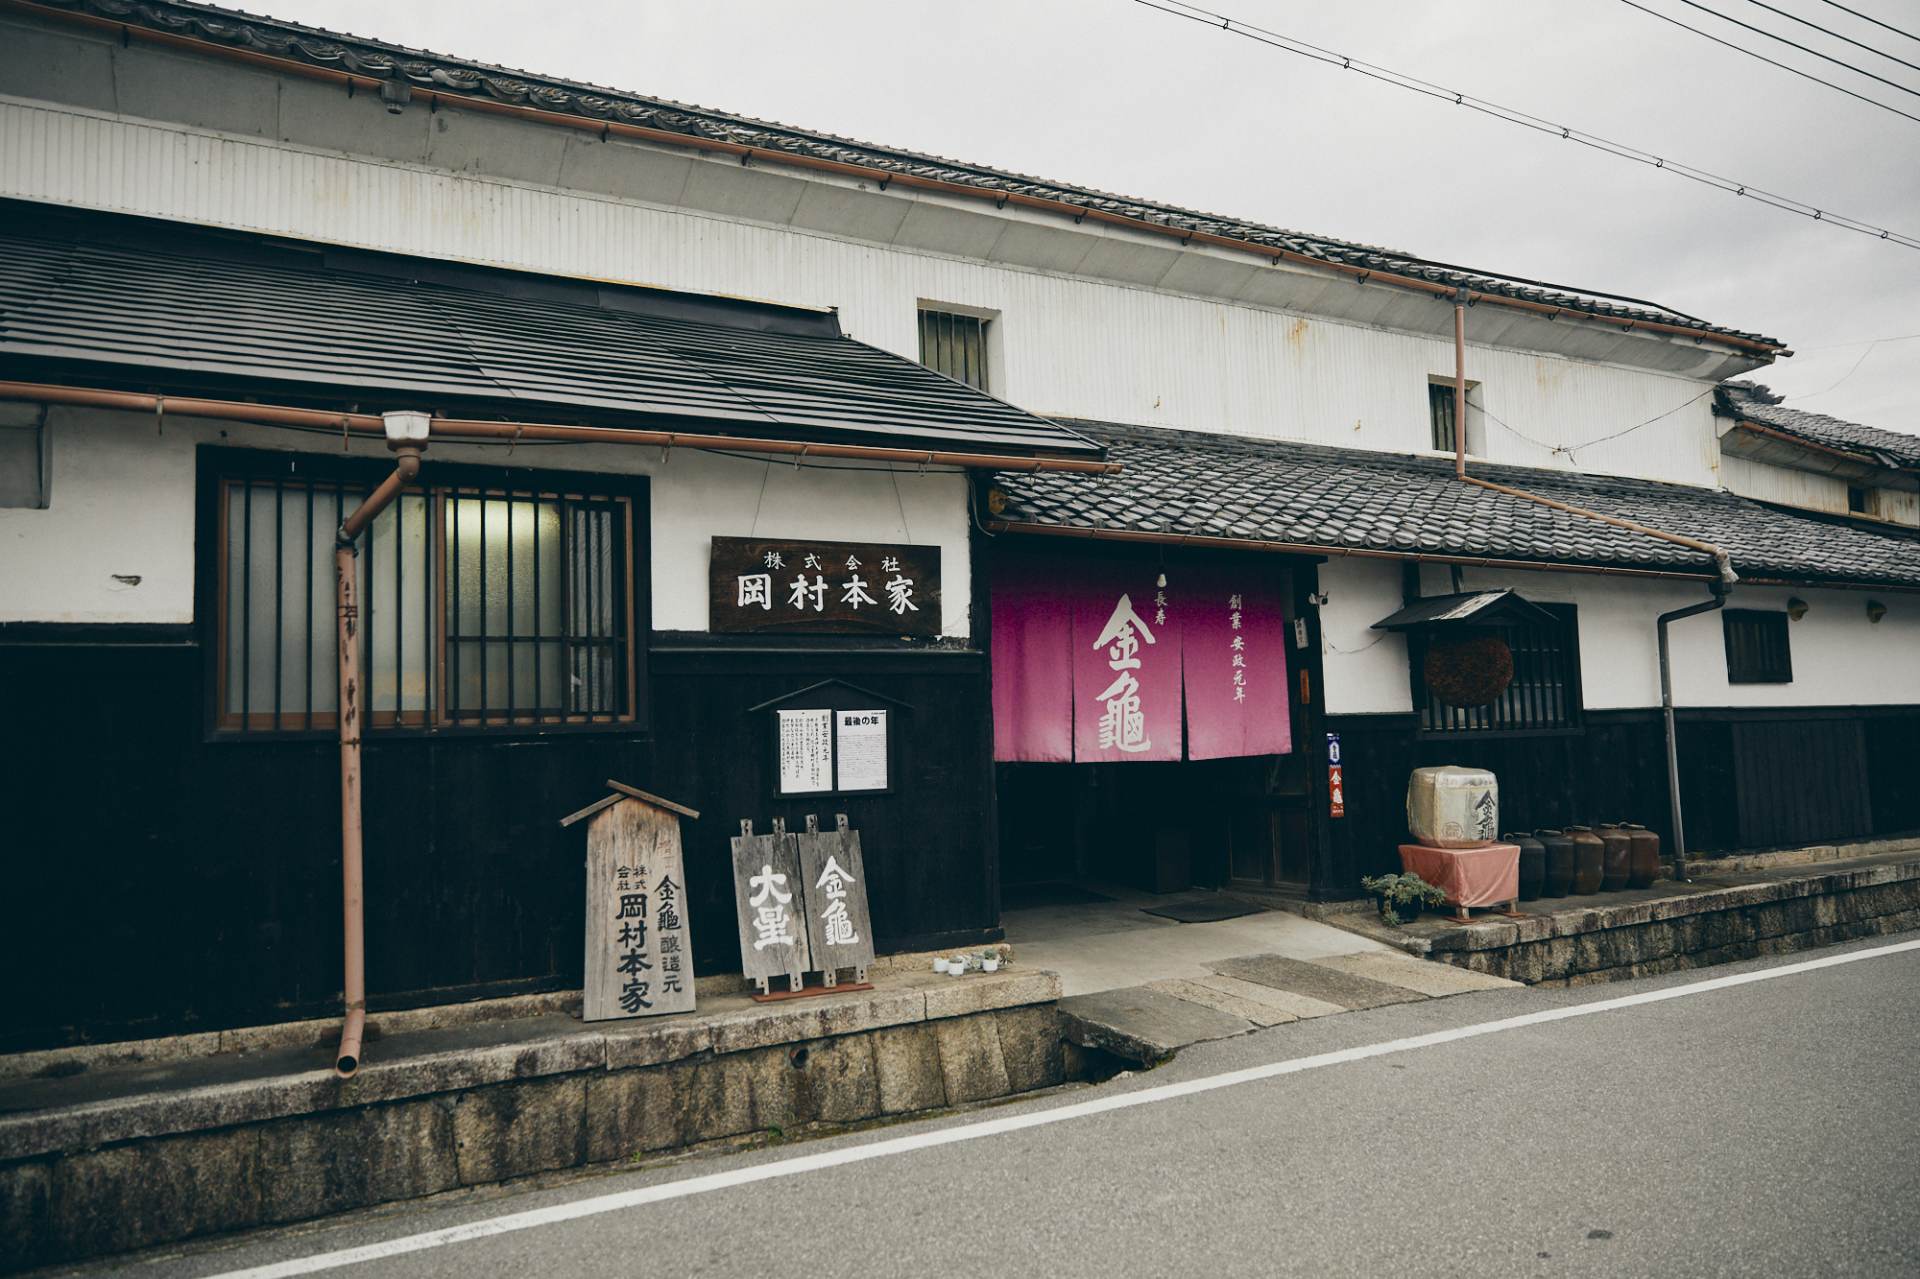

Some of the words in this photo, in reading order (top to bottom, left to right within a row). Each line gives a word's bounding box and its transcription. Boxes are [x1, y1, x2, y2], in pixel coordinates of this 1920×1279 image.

[764, 551, 900, 572] 株式会社
[737, 573, 919, 614] 岡村本家
